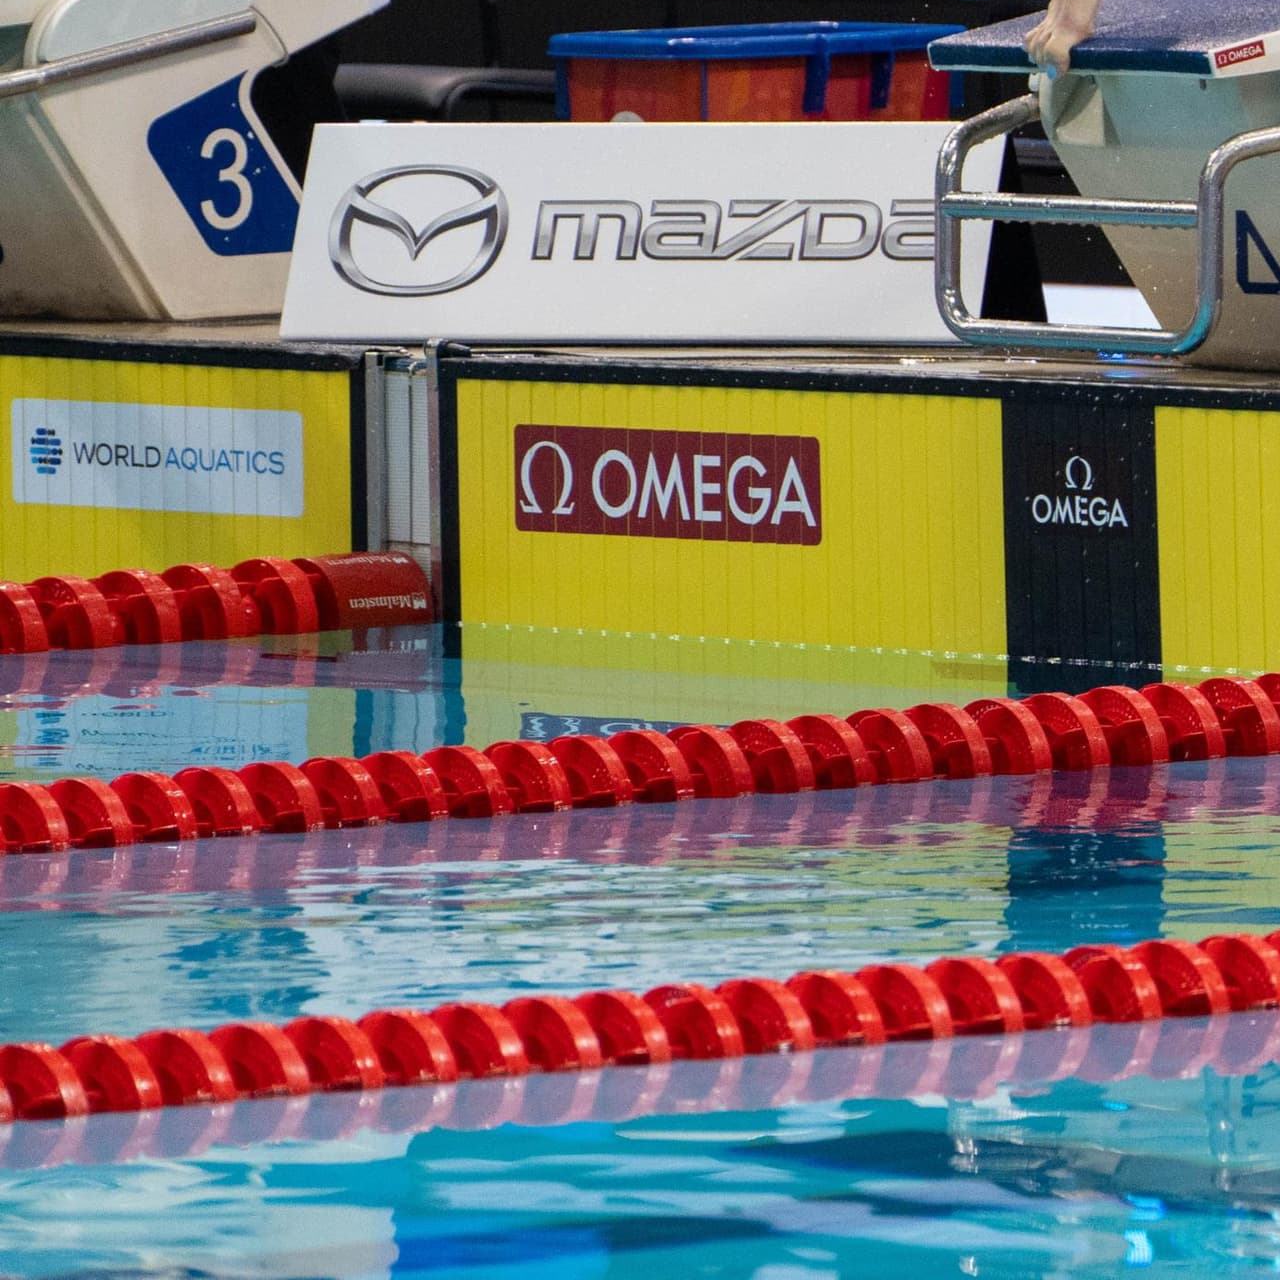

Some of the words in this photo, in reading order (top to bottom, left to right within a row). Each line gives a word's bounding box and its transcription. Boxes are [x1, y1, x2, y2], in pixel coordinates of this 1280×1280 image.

[1228, 44, 1264, 62] OMEGA
[200, 128, 253, 230] 3
[73, 441, 161, 470] WORLD
[164, 446, 286, 476] AQUATICS
[592, 448, 817, 527] OMEGA
[1031, 493, 1128, 529] OMEGA
[349, 595, 412, 609] Malmsten
